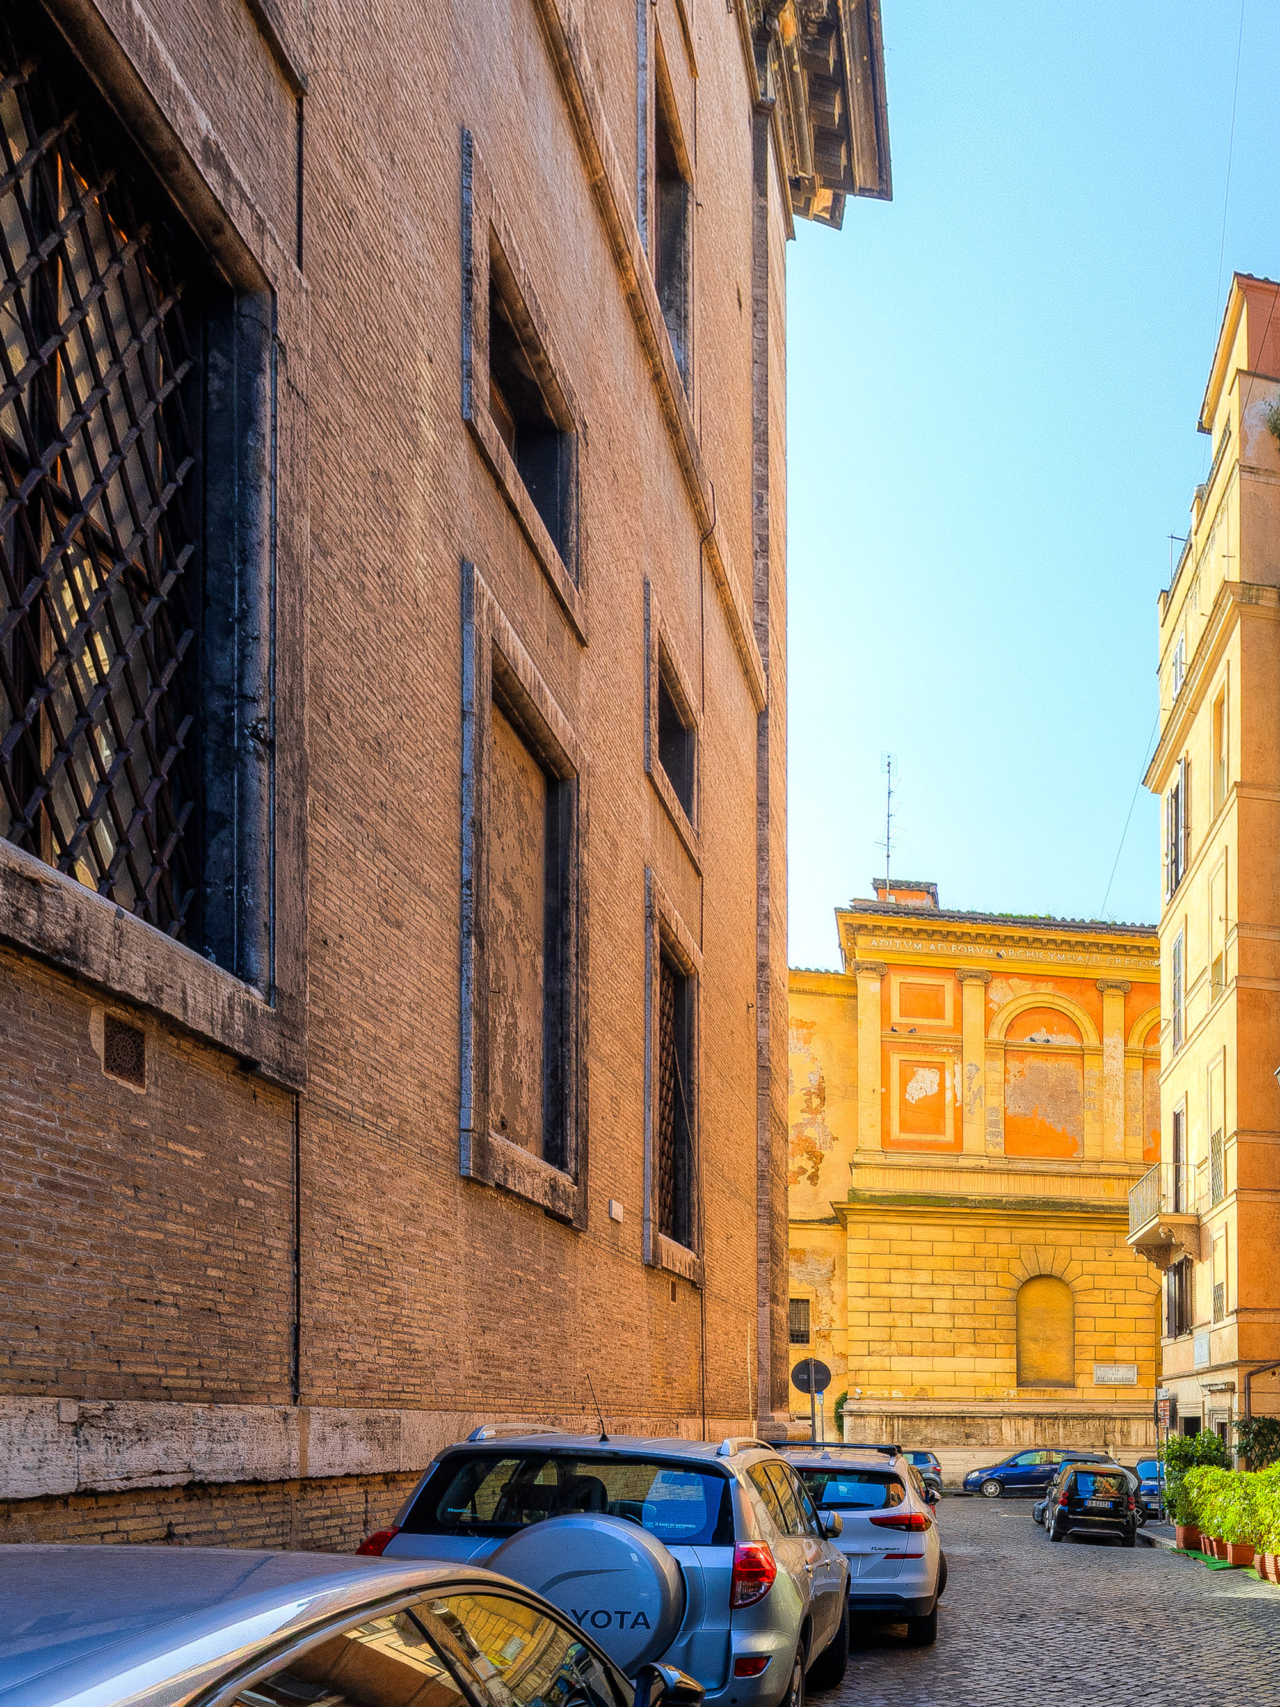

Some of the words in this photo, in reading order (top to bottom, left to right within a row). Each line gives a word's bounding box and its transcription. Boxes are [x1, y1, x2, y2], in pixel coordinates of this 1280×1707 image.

[870, 939, 922, 950] ADITVM
[929, 943, 947, 951] AD
[951, 944, 994, 955] FORVM
[560, 1608, 652, 1630] YOTA
